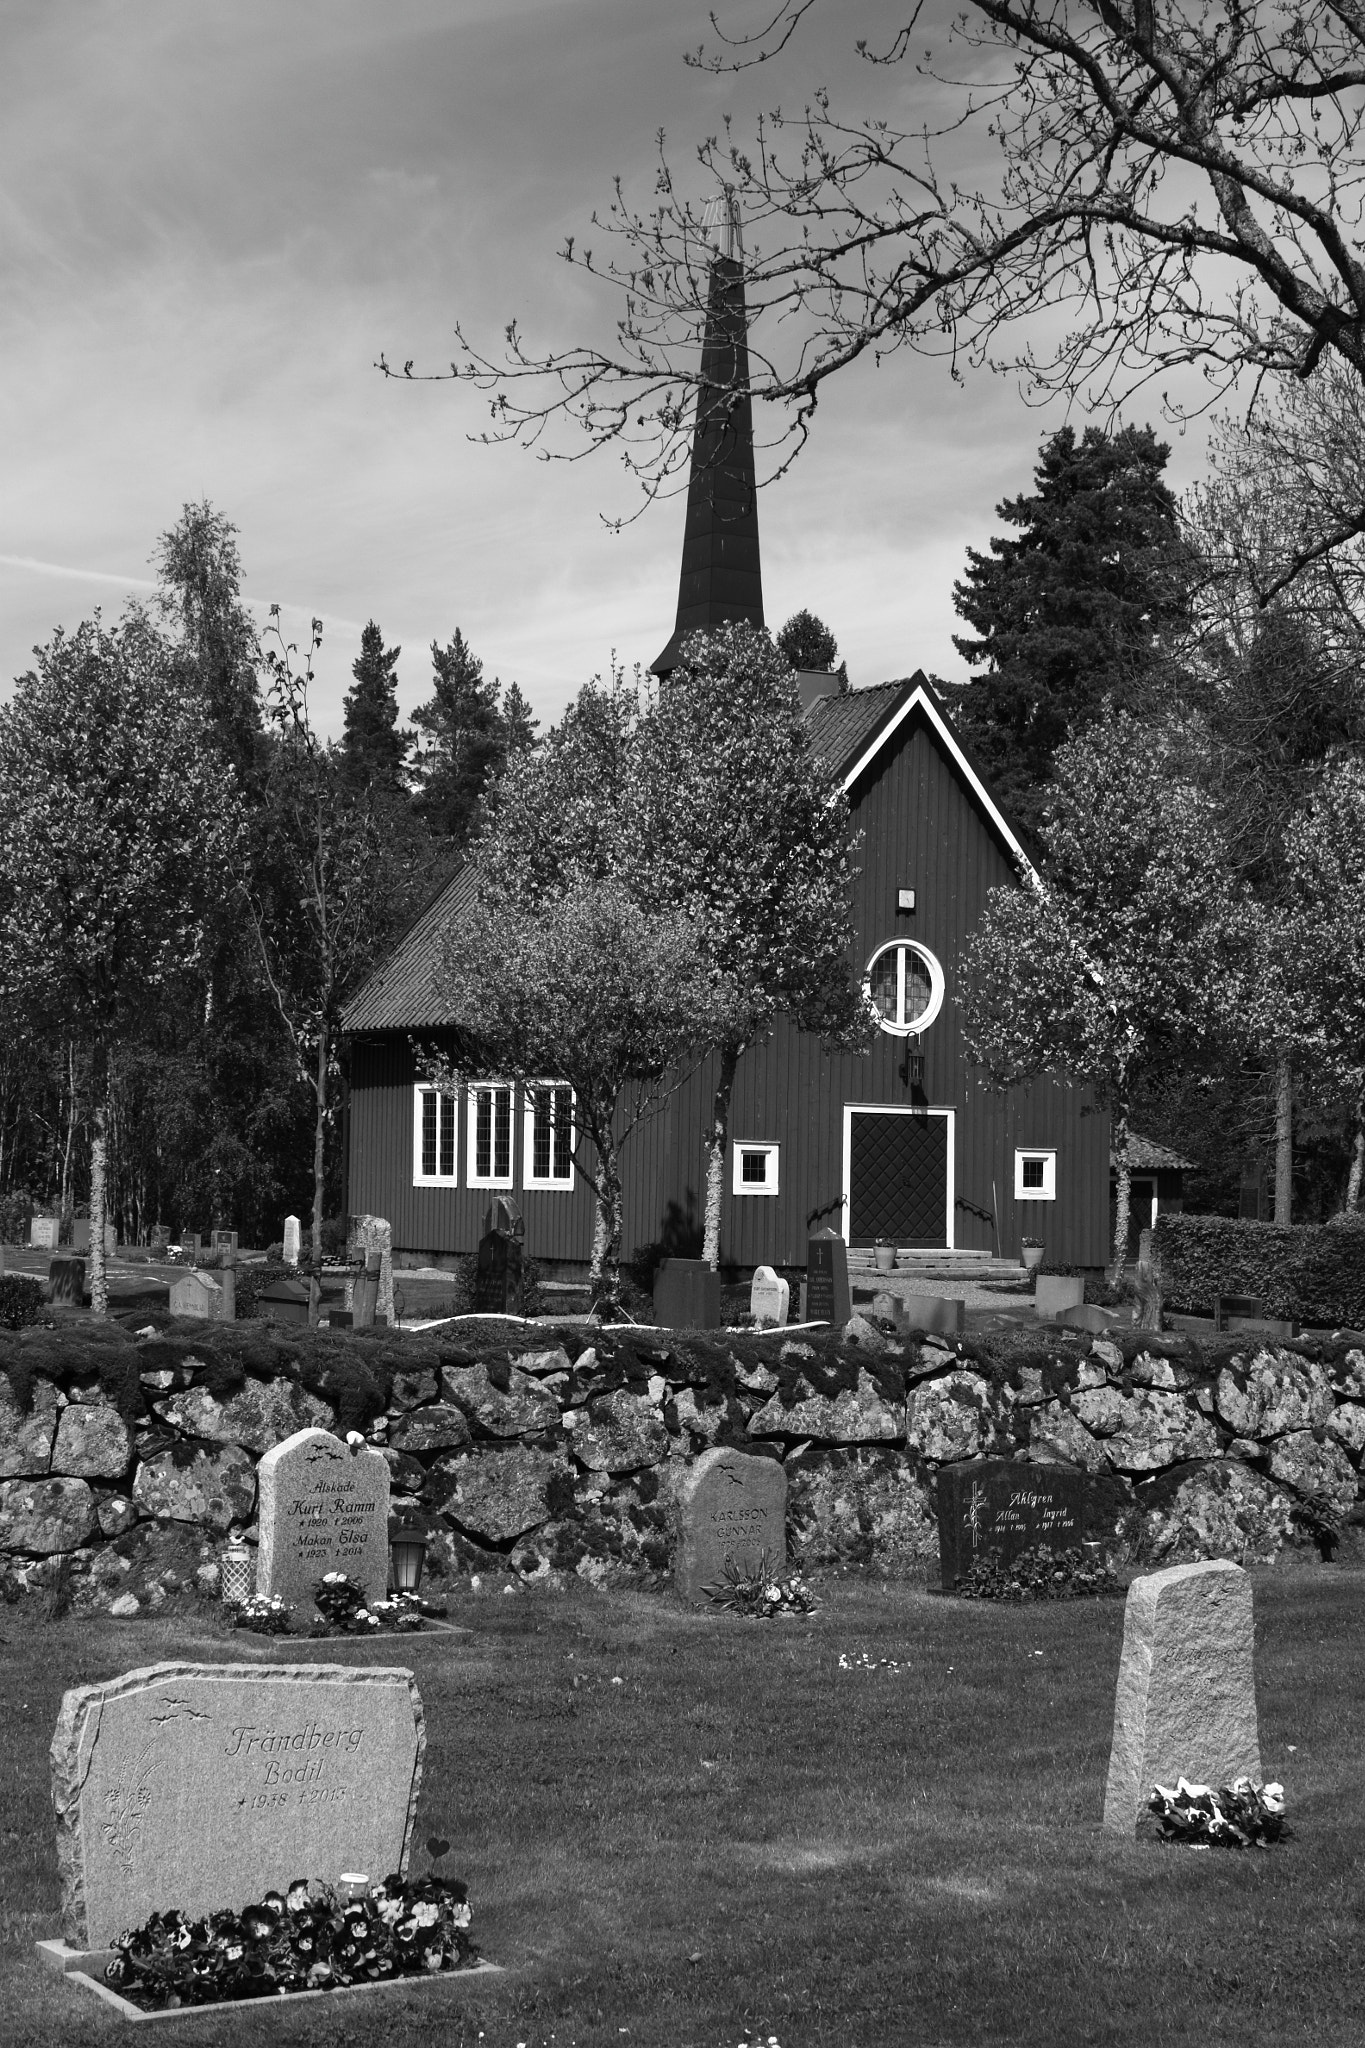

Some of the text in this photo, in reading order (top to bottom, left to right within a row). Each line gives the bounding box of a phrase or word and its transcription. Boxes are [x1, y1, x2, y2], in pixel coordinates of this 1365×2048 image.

[288, 1498, 376, 1516] Kurt Ramm
[1009, 1491, 1053, 1508] Ahlgren
[711, 1508, 768, 1522] KARLSSON
[293, 1529, 368, 1546] Makan Elsa
[717, 1524, 762, 1538] GUNNAR
[225, 1721, 364, 1756] Frändberg
[264, 1758, 324, 1785] Bodil
